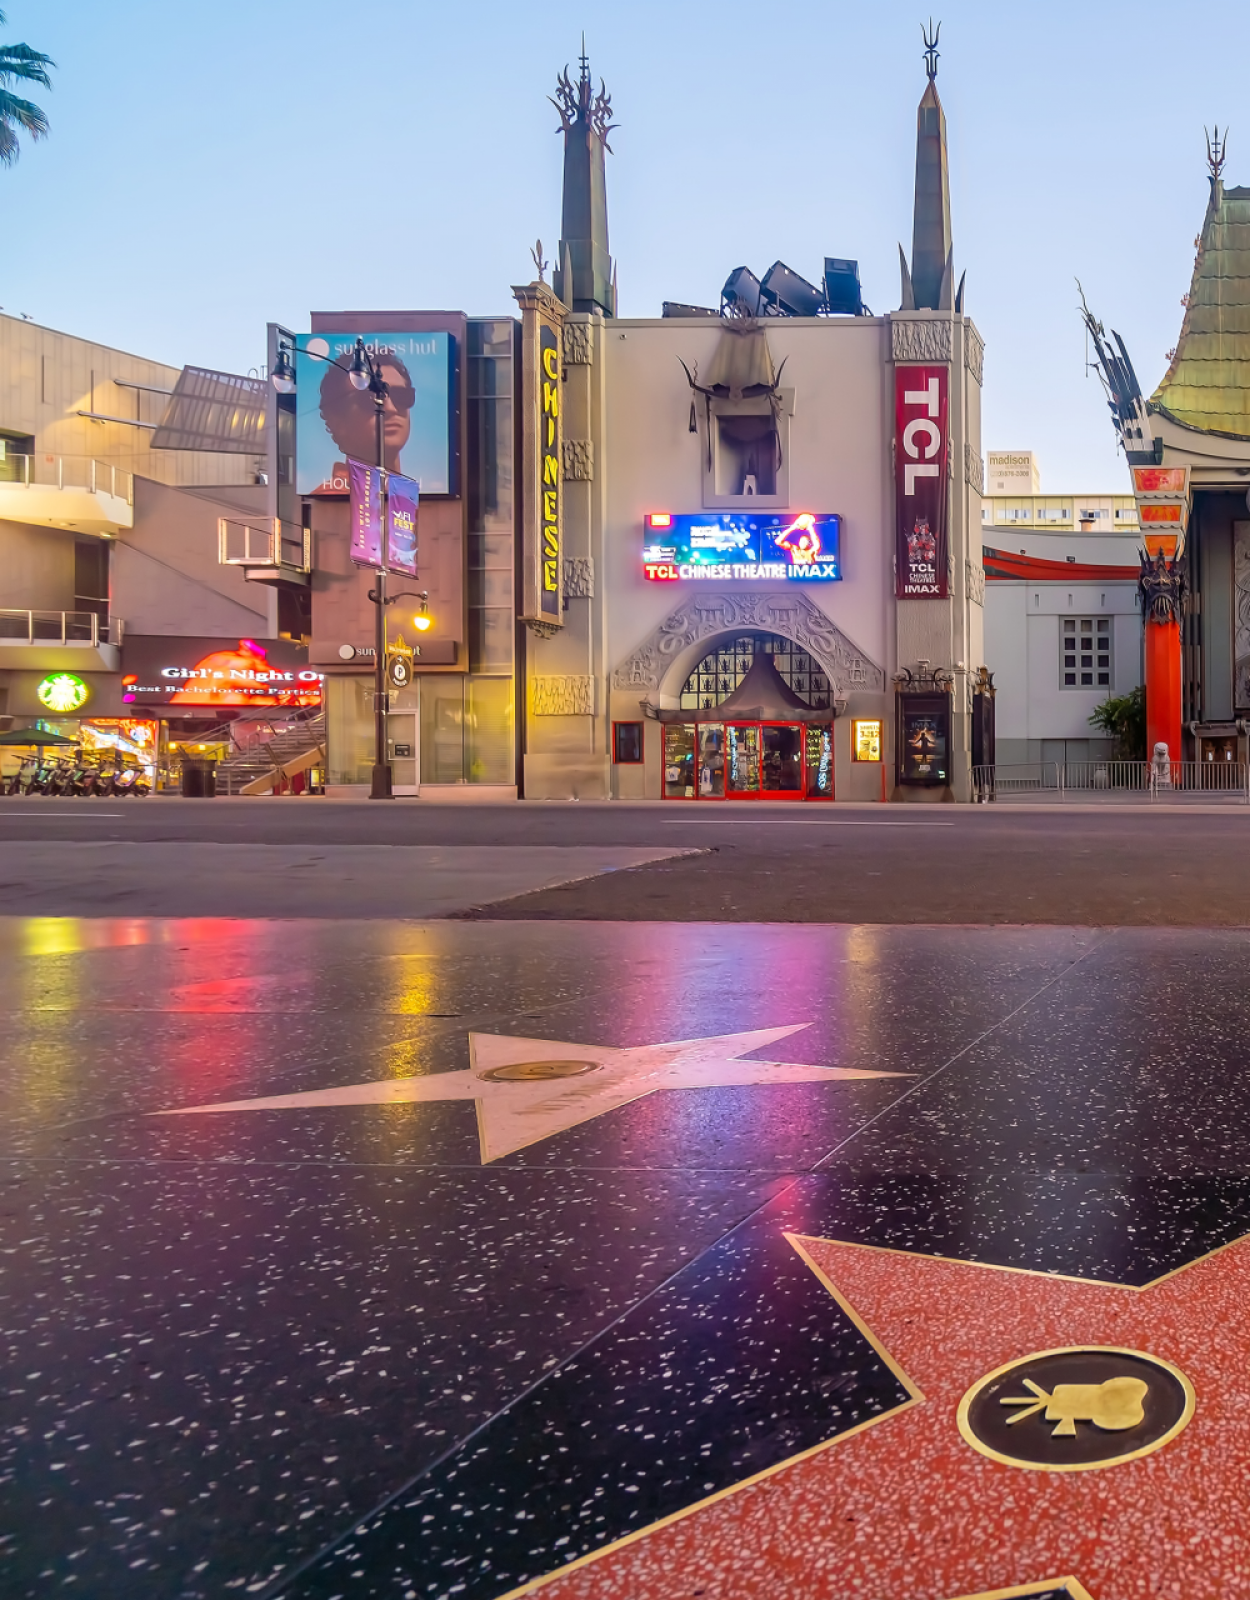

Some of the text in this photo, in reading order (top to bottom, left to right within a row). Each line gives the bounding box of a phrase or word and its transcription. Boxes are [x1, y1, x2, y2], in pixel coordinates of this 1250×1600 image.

[410, 338, 437, 355] hut
[904, 377, 940, 496] TCL
[990, 455, 1030, 465] madison
[544, 348, 559, 591] CHINESE
[394, 518, 414, 531] FEST
[646, 564, 836, 579] TCL CHINESE THEATRE IMAX
[909, 563, 935, 572] TCL
[904, 585, 940, 593] IMAX
[162, 668, 225, 679] Girl's
[230, 669, 294, 682] Night
[127, 684, 320, 696] Best Bachelorette Parties
